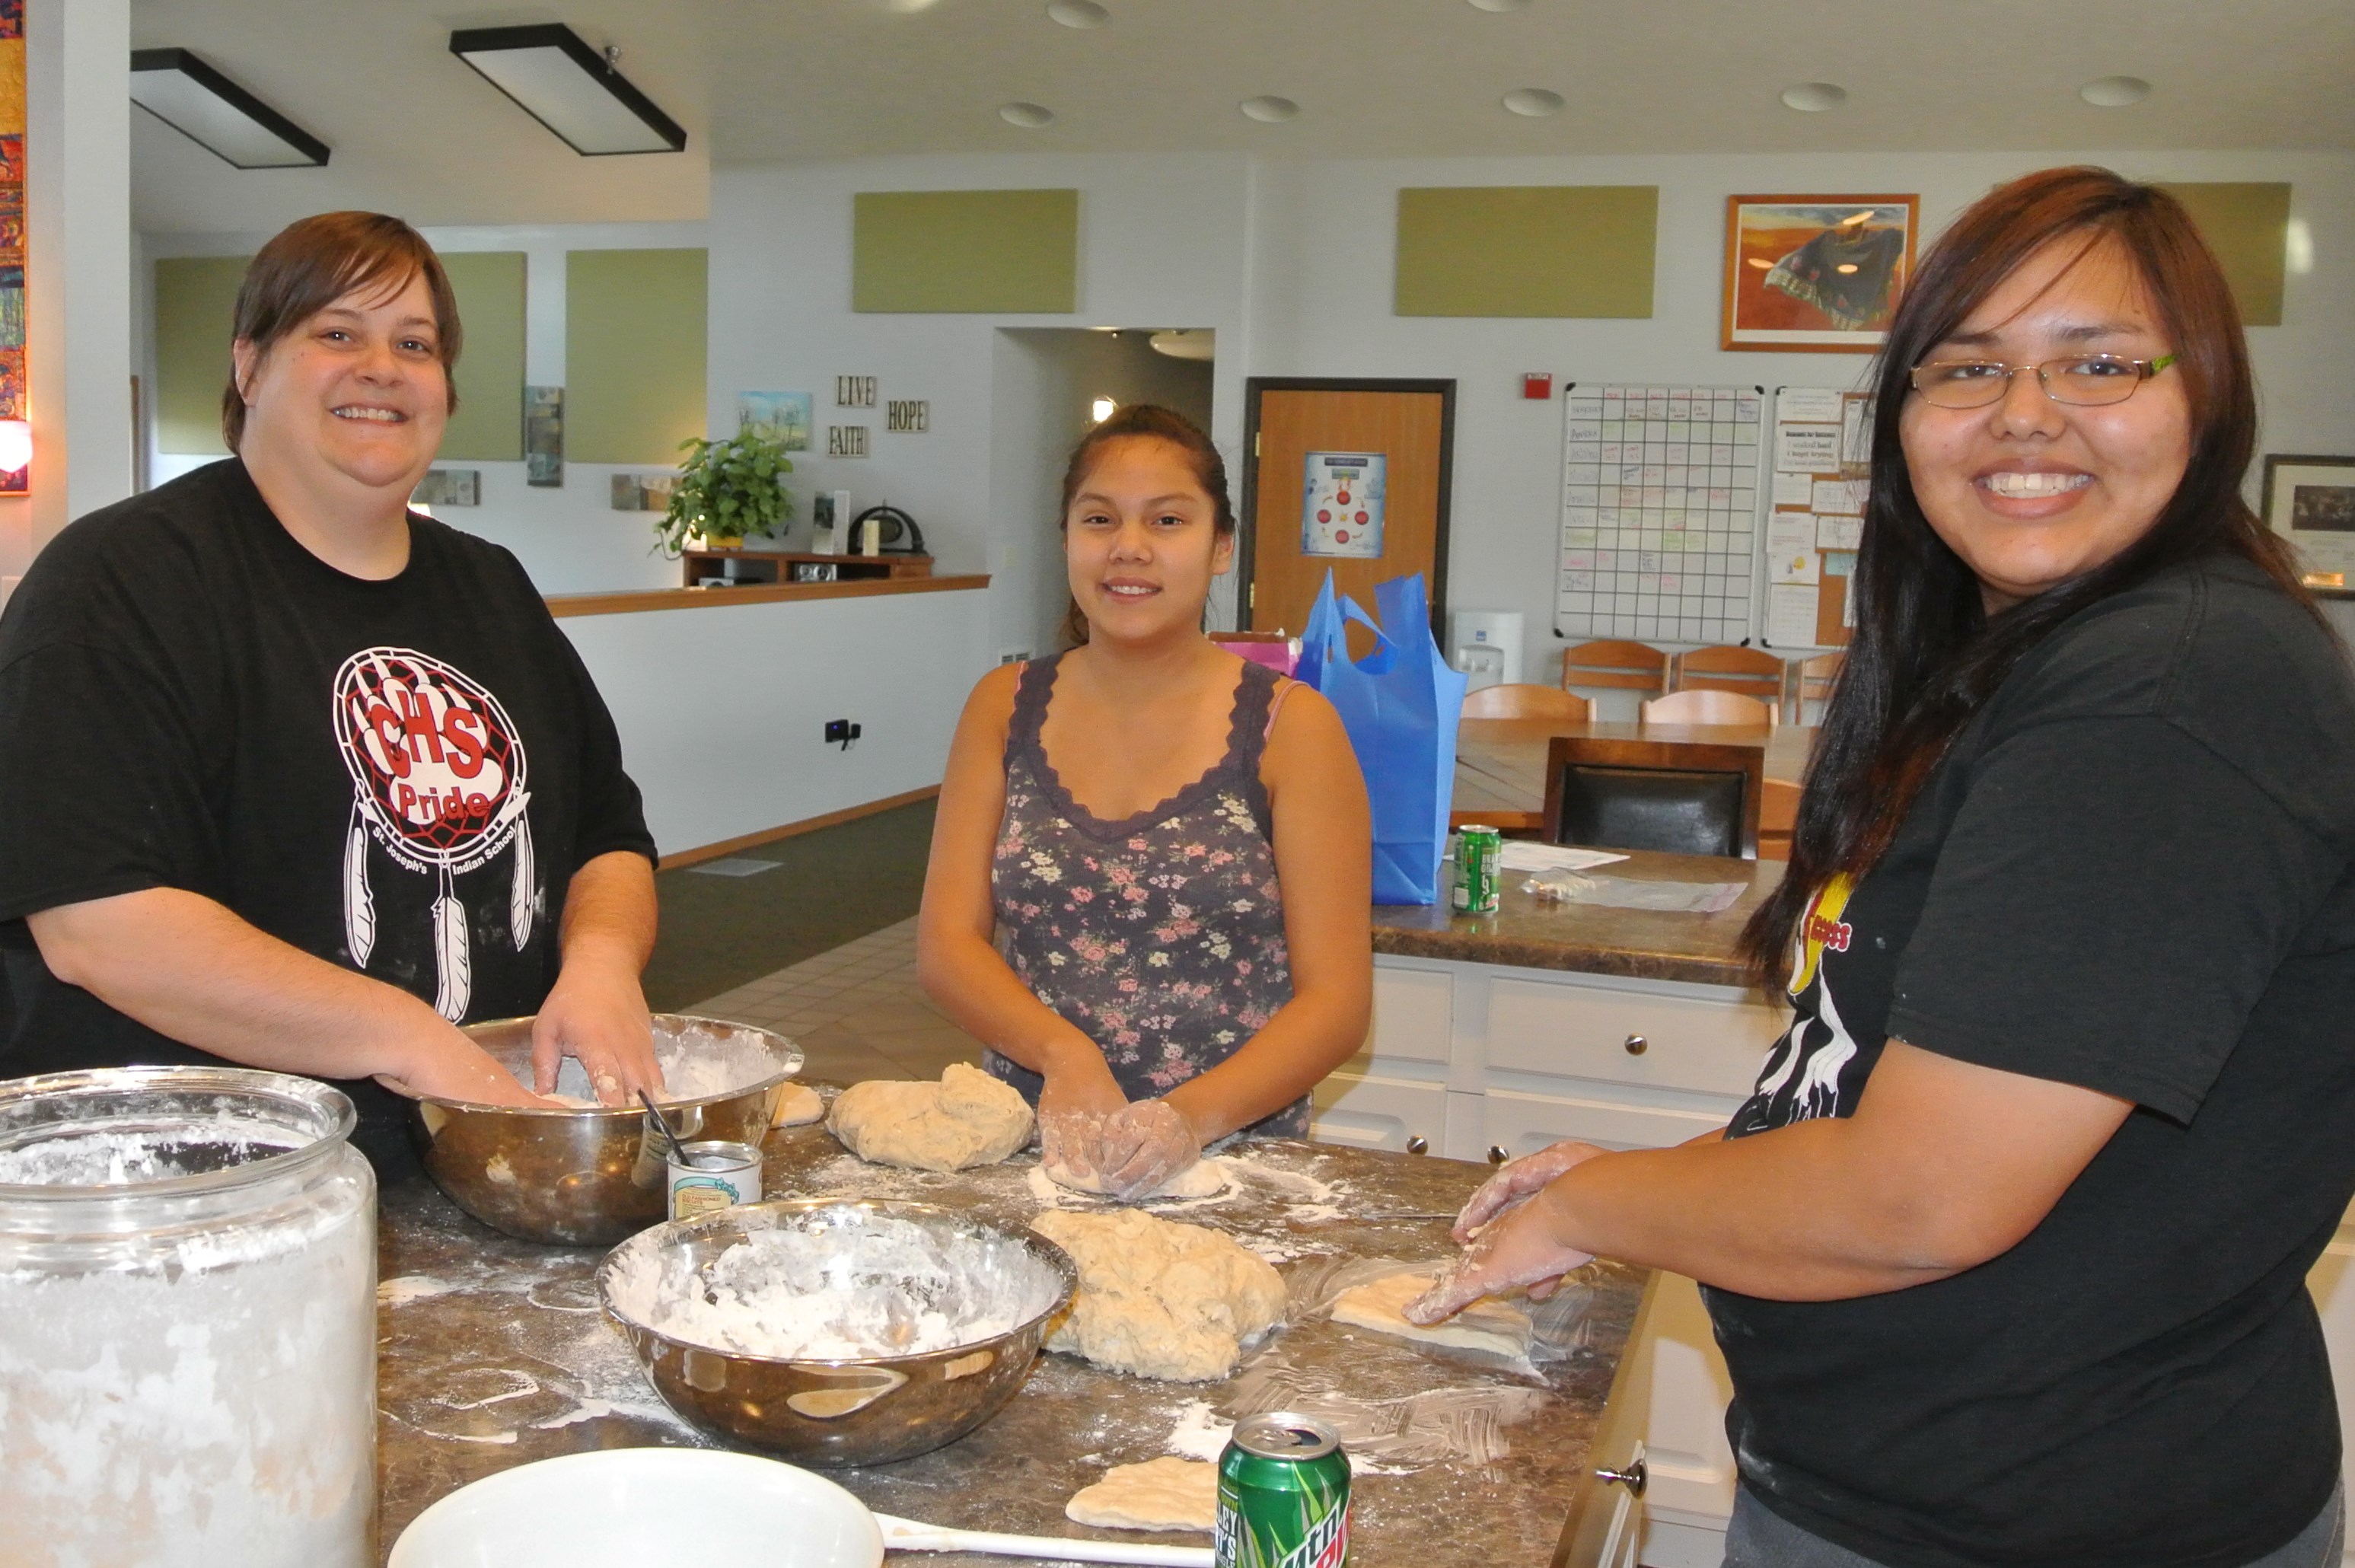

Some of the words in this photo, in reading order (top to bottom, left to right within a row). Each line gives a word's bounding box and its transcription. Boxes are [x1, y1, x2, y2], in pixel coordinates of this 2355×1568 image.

[837, 375, 874, 406] LIVE
[888, 400, 925, 431] HOPE
[829, 425, 864, 455] FAITH
[371, 689, 485, 779] CHS
[398, 782, 491, 822] Pride
[372, 826, 386, 845] St.
[386, 843, 428, 875] Joseph's
[452, 856, 486, 875] Indian
[484, 825, 517, 860] School
